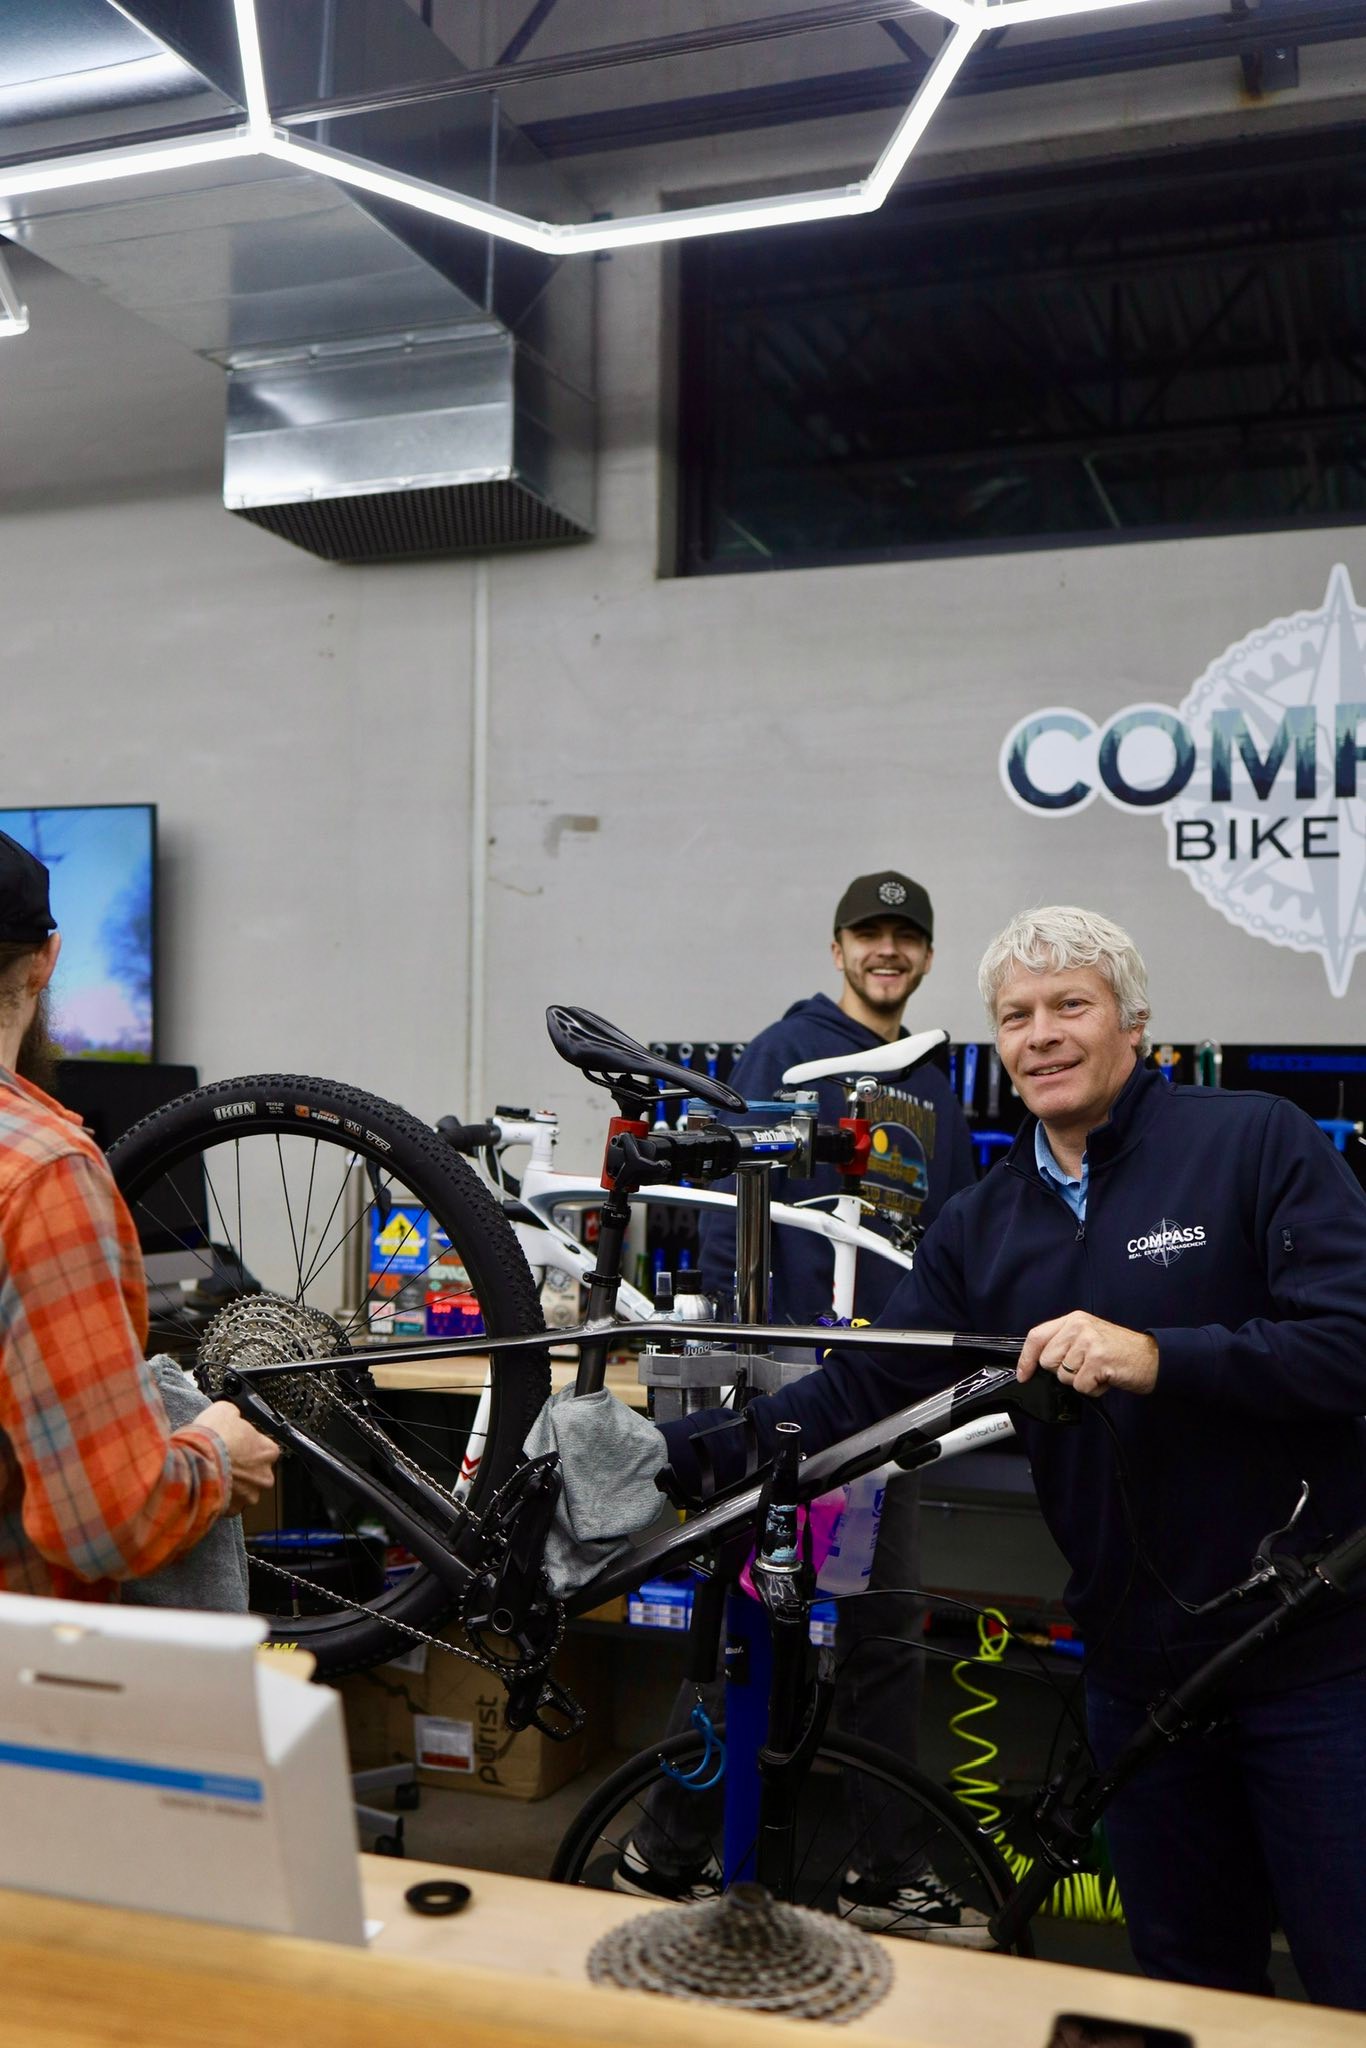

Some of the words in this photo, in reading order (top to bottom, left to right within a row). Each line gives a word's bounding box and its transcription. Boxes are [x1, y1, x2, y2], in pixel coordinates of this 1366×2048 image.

[1176, 816, 1340, 861] BIKE
[214, 1101, 256, 1121] IKON
[366, 1130, 391, 1151] TR
[1127, 1226, 1206, 1253] COMPASS
[1128, 1252, 1142, 1260] REAL
[1166, 1240, 1206, 1251] MANAGEMENT
[475, 1694, 504, 1787] purist
